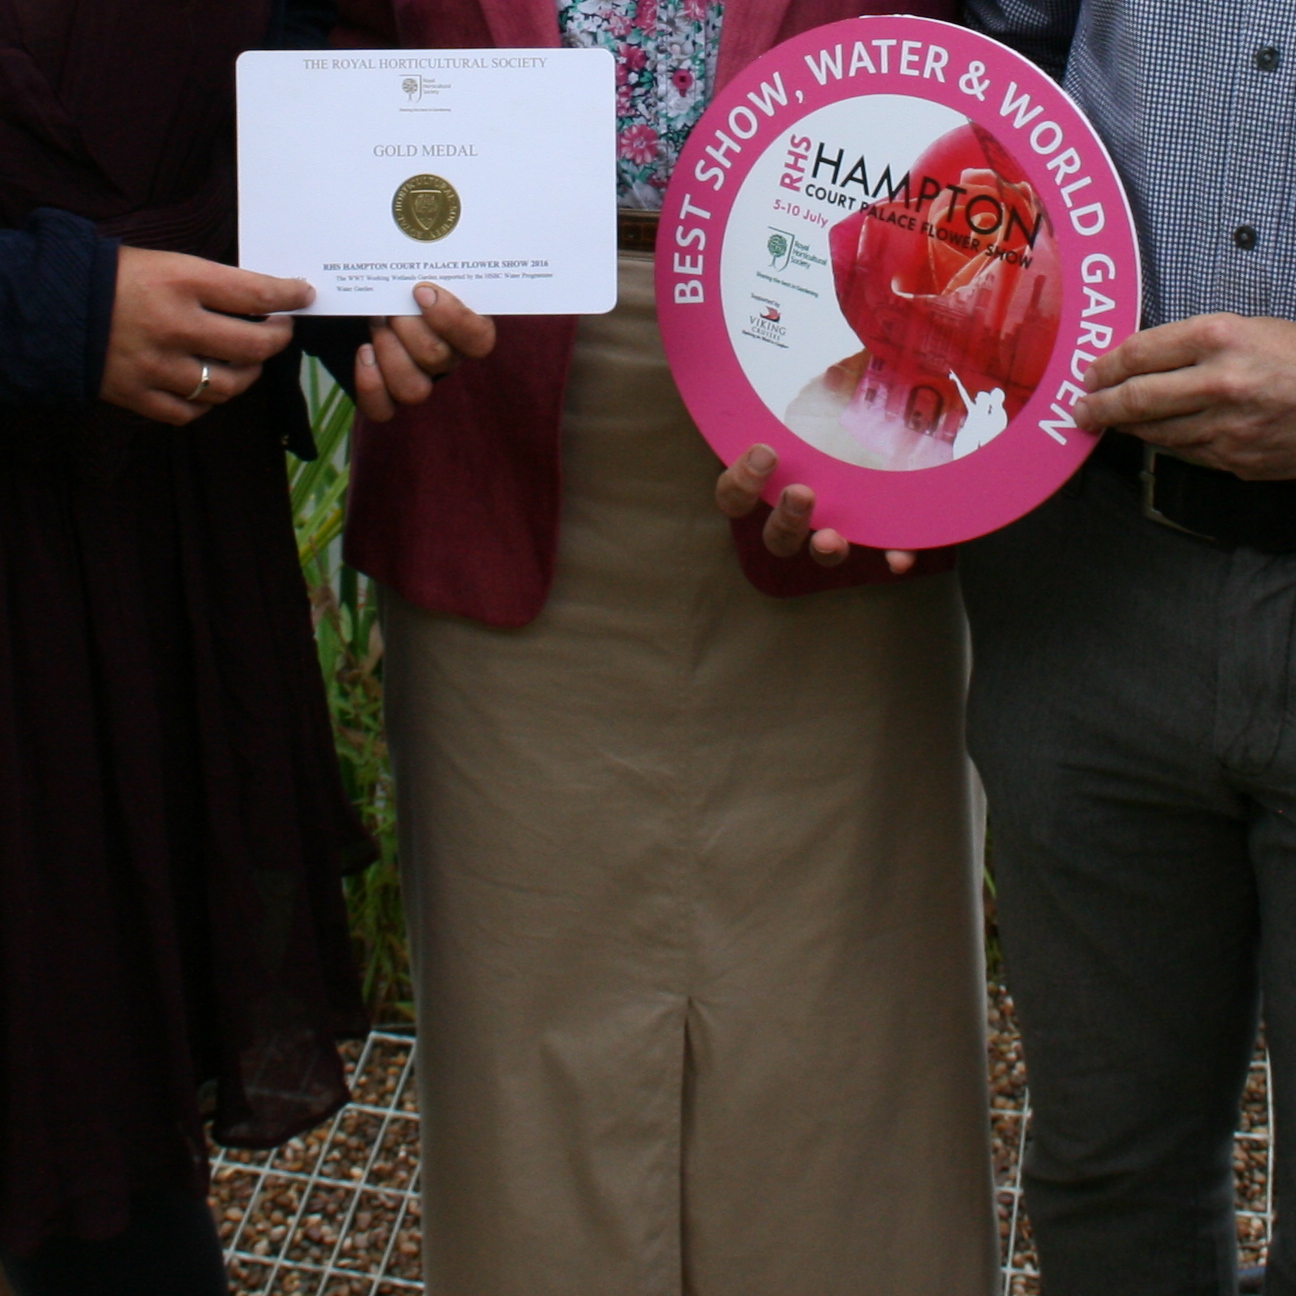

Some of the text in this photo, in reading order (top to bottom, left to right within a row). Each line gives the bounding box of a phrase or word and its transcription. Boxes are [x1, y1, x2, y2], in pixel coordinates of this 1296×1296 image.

[303, 57, 548, 70] THE ROYAL HORTICULTURAL SOCIETY
[373, 144, 478, 157] GOLD MEDAL
[779, 134, 812, 192] RHS
[673, 194, 712, 304] BEST
[694, 71, 804, 191] SHOW,
[804, 39, 949, 86] WATER
[958, 60, 991, 102] &
[999, 81, 1105, 236] WORLD
[811, 142, 1042, 251] HAMPTON
[773, 198, 829, 229] 5-10 July
[805, 183, 1034, 270] COURT PALACE FLOWER SHOW
[323, 259, 549, 271] RHS HAMPTON COURT PALACE FLOWER SHOW 2016
[749, 315, 787, 336] VIKING
